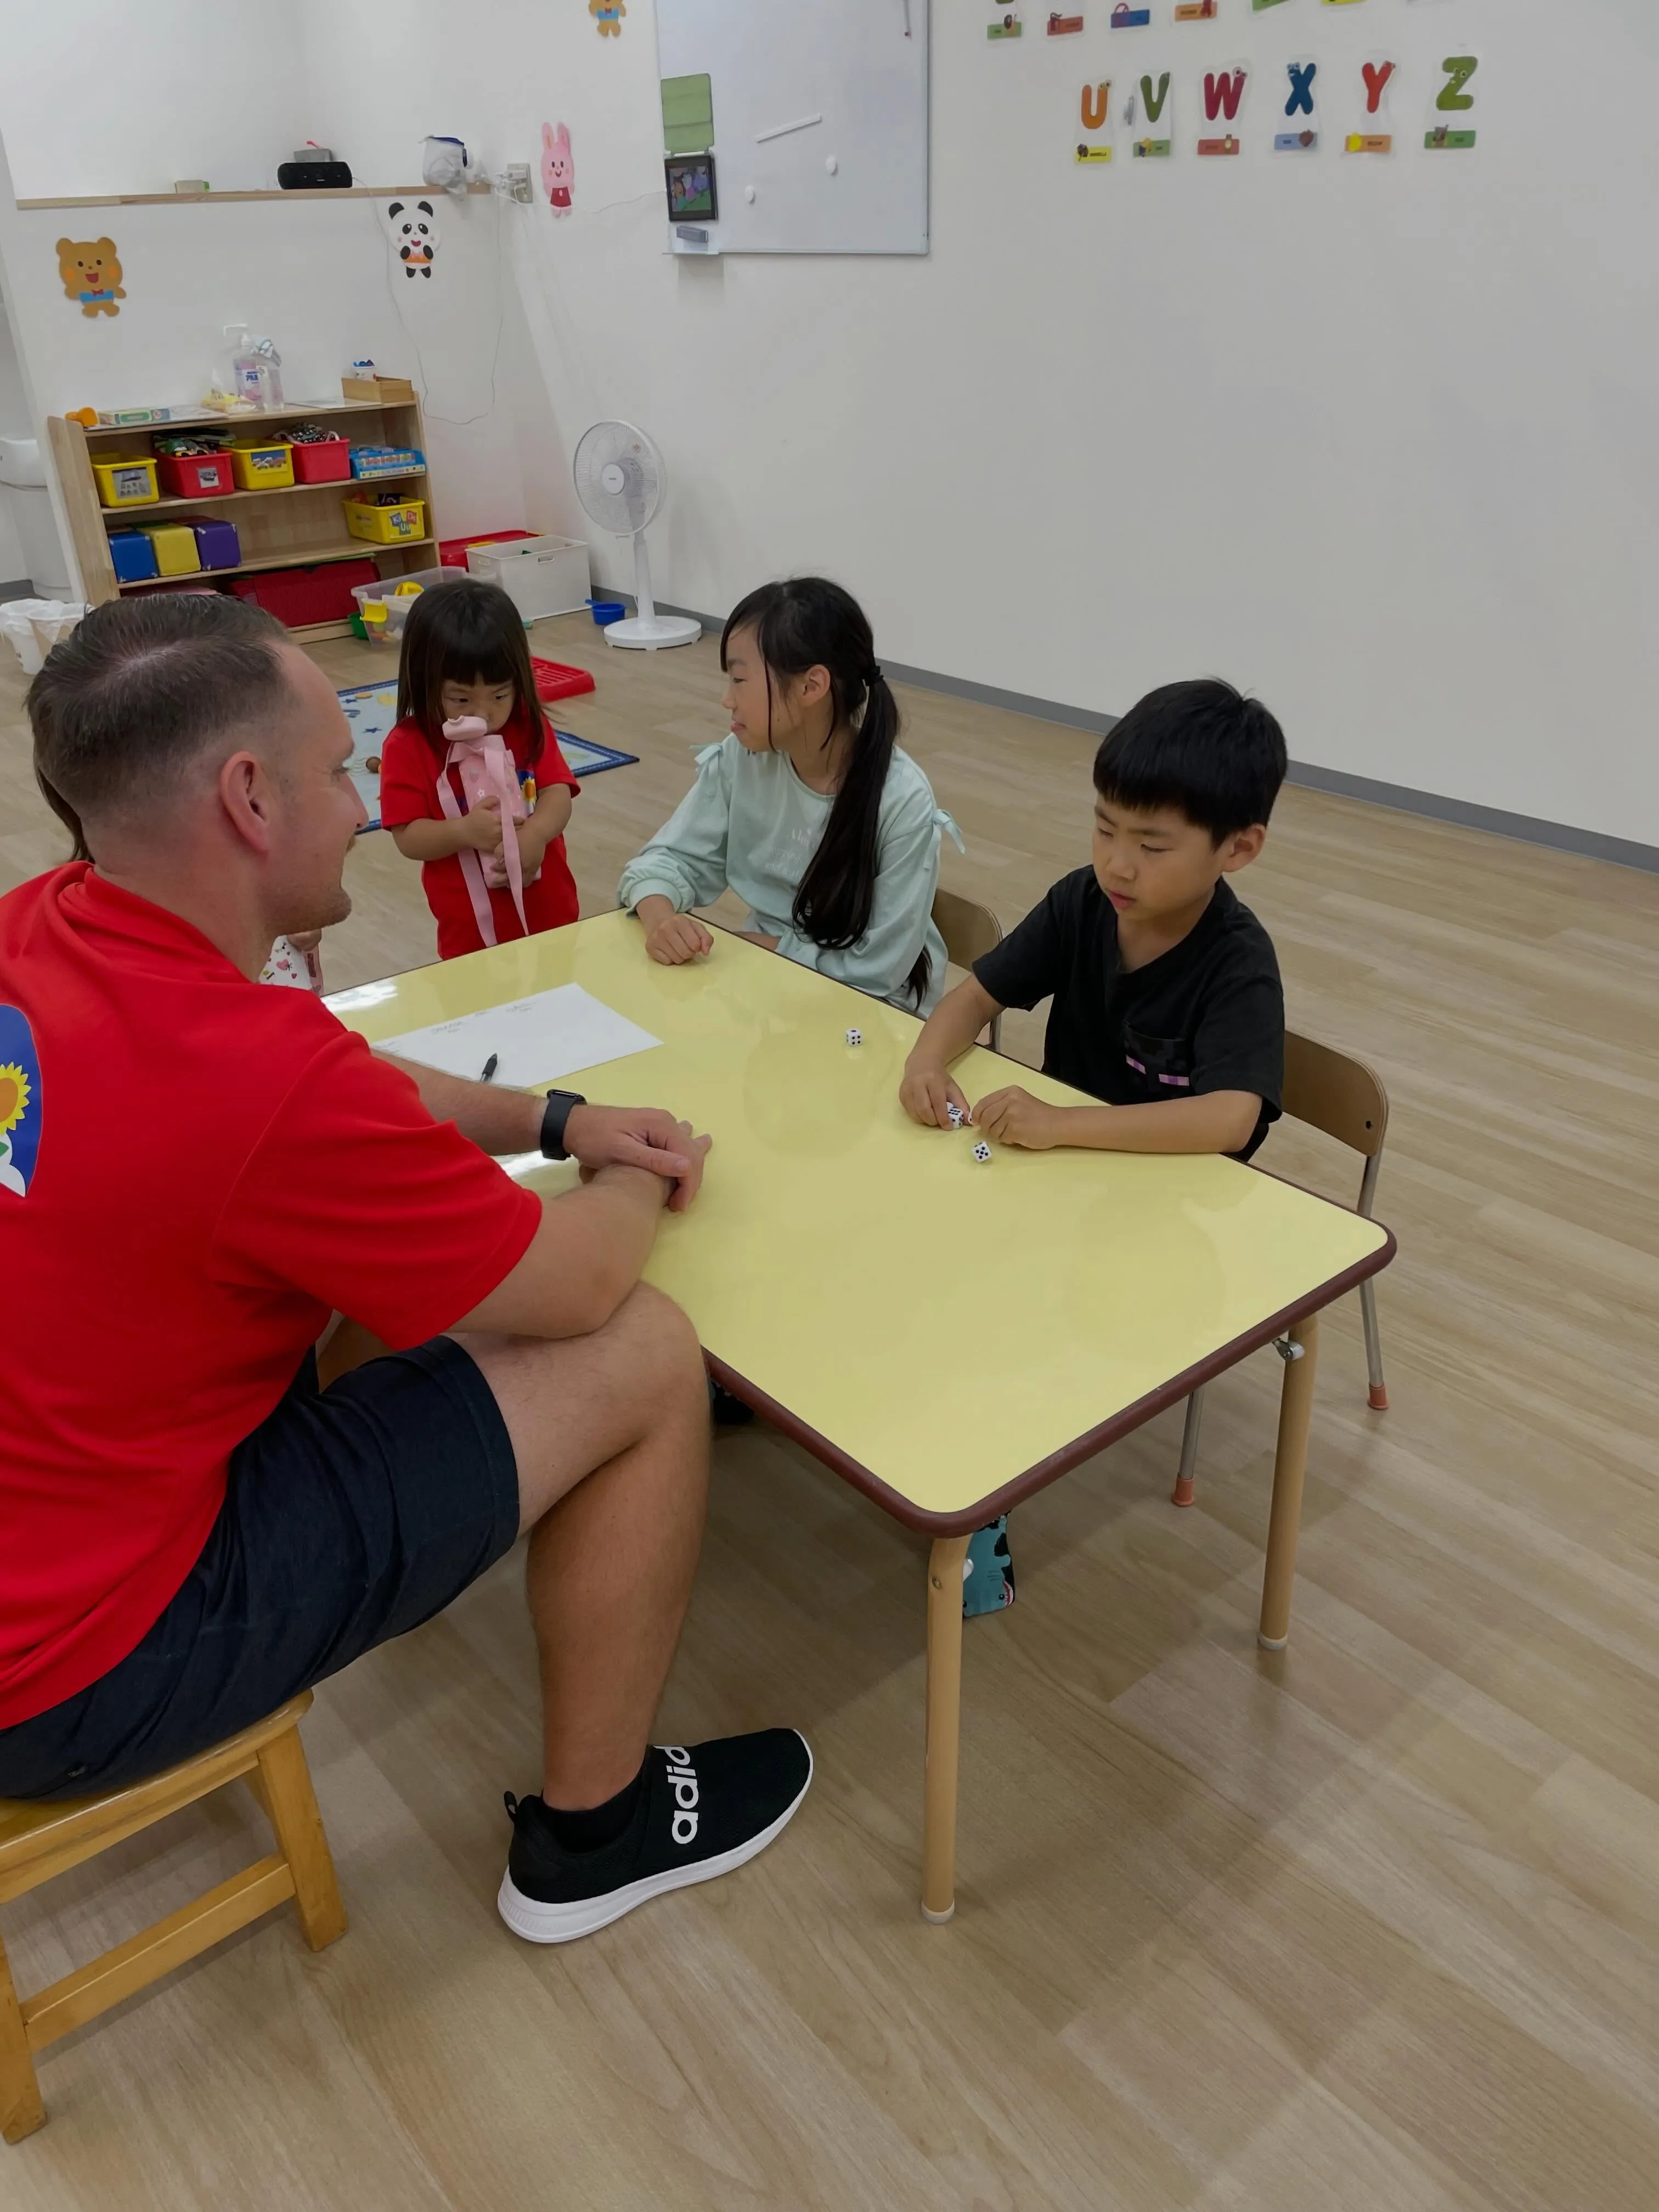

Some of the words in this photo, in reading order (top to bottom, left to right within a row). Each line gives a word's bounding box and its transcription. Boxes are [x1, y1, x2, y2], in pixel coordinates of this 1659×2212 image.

[1081, 82, 1109, 129] U
[1140, 72, 1170, 122] V
[1204, 71, 1245, 121] W
[1285, 62, 1316, 116] X
[1362, 61, 1394, 113] Y
[1436, 56, 1478, 110] Z
